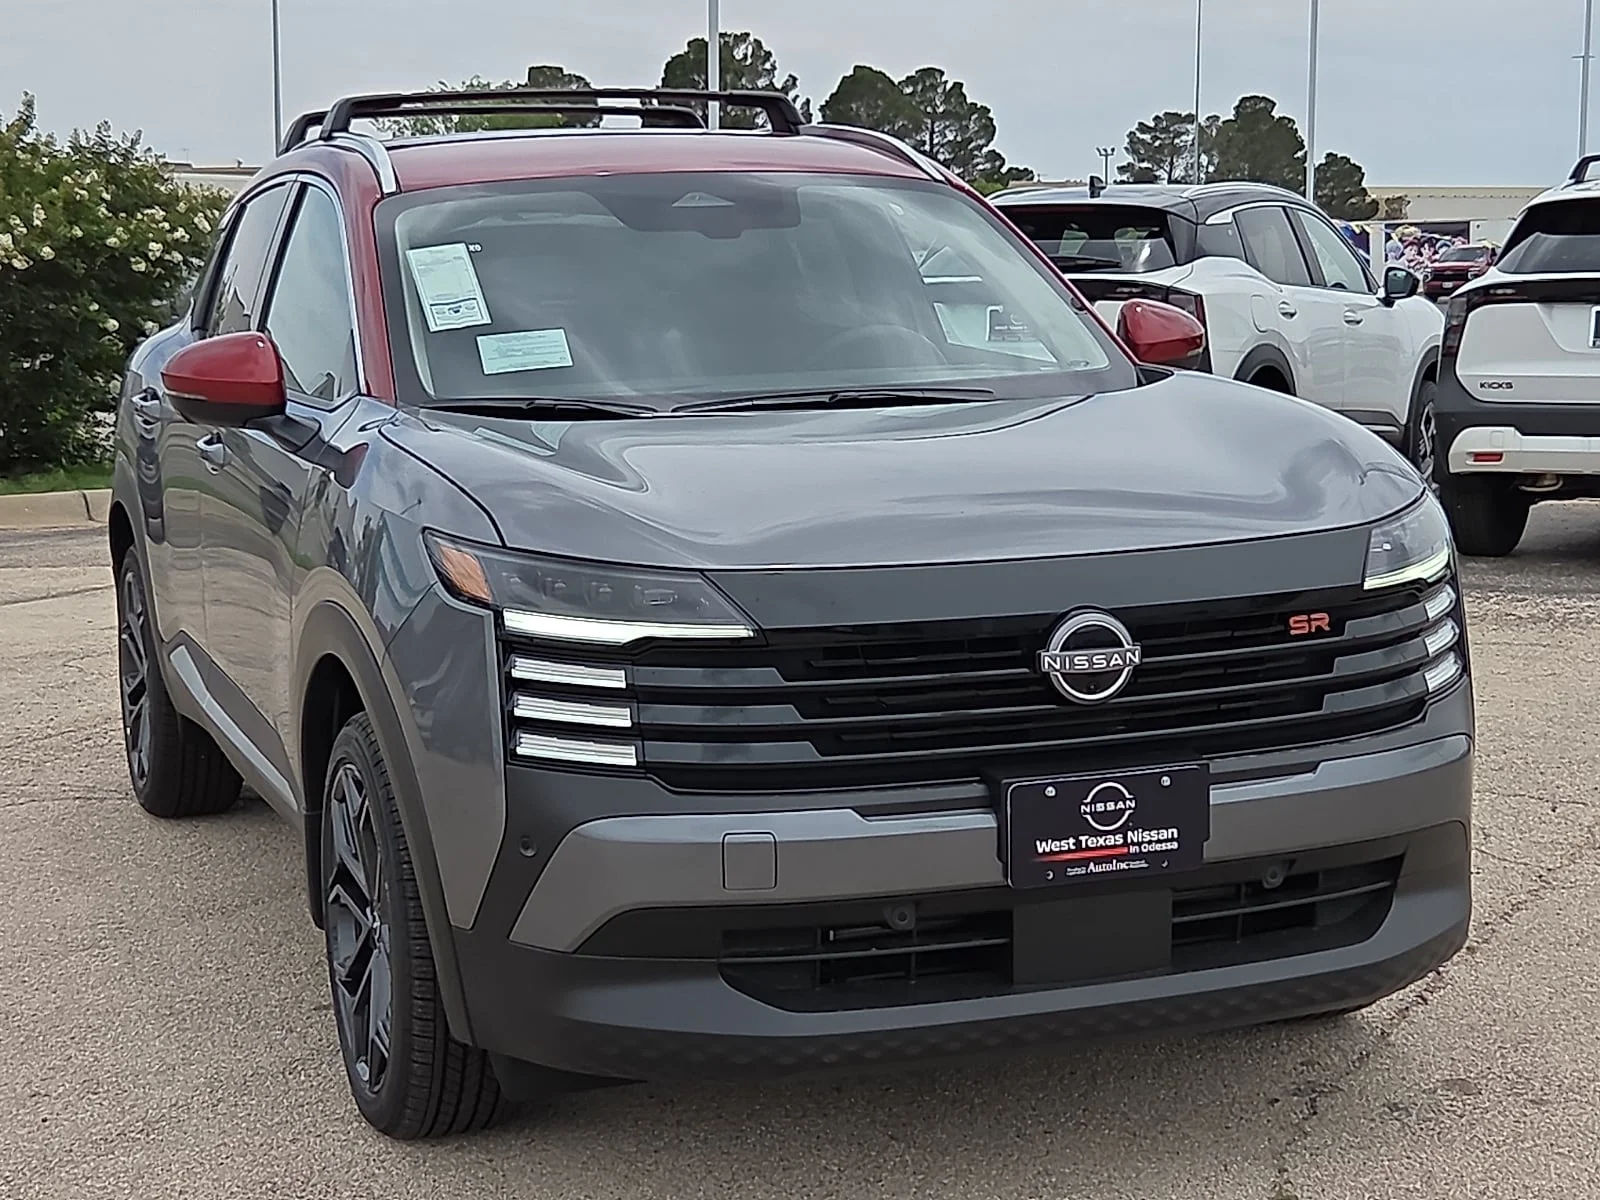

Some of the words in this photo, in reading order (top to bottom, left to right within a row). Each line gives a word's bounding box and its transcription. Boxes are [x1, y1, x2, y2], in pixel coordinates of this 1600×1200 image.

[1480, 381, 1513, 389] KICKS
[1289, 613, 1331, 635] SR
[1044, 650, 1139, 670] NISSAN
[1081, 800, 1135, 813] NISSAN
[1036, 837, 1076, 853] West
[1079, 834, 1124, 849] Texas
[1127, 828, 1178, 843] Nissan
[1141, 841, 1178, 853] Odessa
